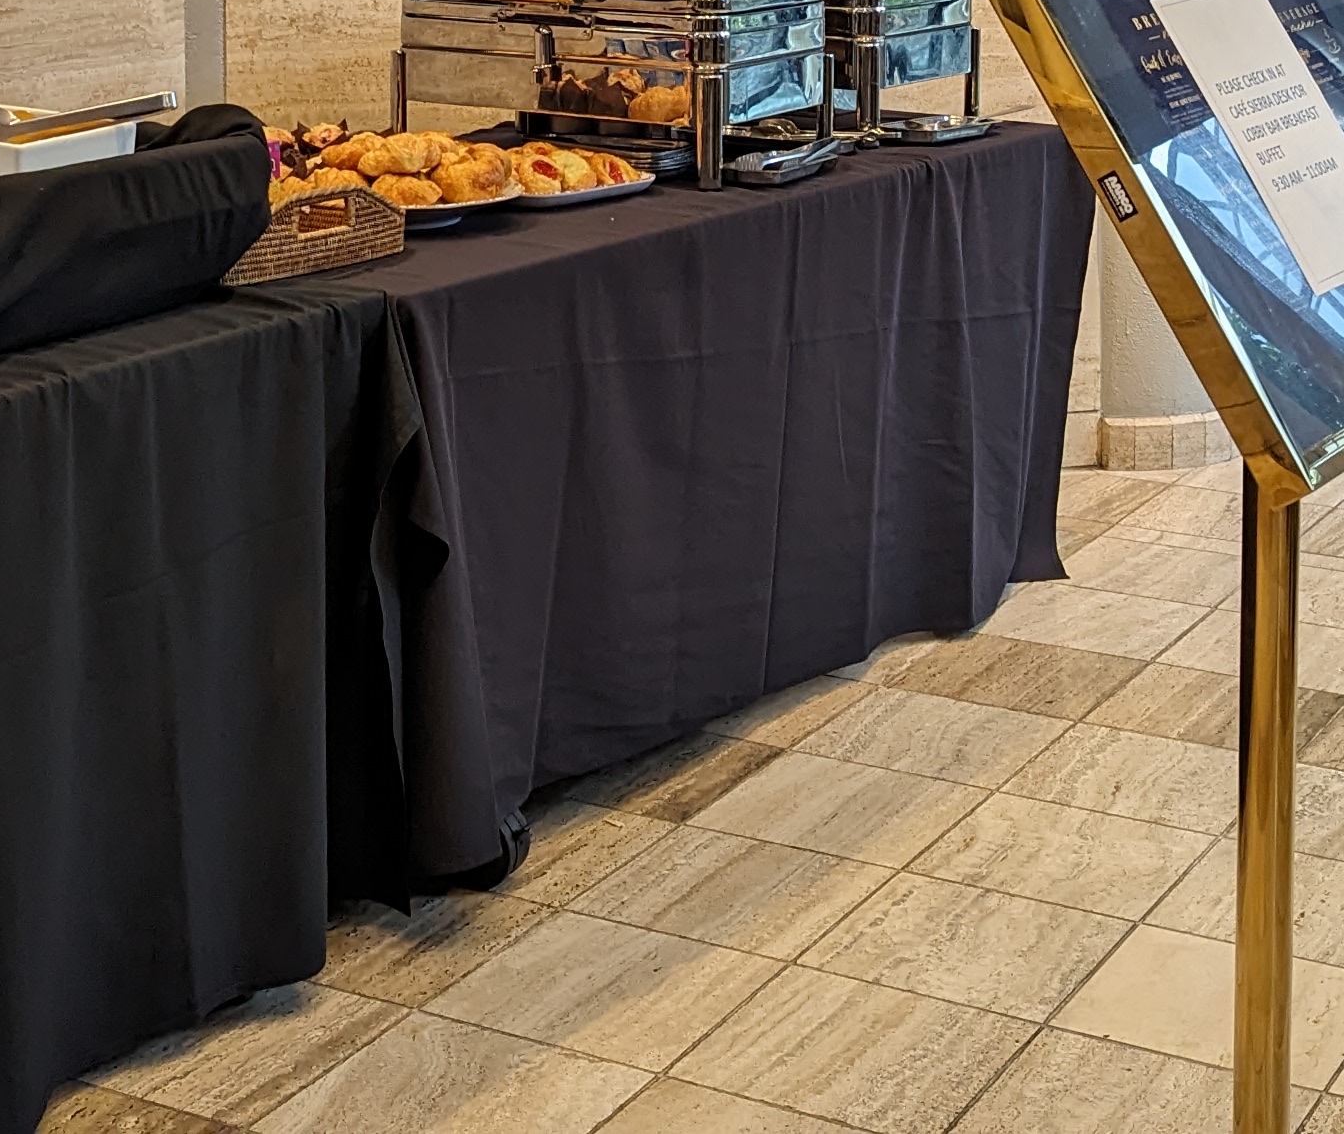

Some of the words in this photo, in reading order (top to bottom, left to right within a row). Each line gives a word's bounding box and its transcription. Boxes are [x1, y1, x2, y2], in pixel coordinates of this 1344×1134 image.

[1277, 2, 1320, 23] EVERAGE
[1215, 77, 1244, 96] PLEASE
[1242, 68, 1268, 88] CHECK
[1266, 66, 1276, 81] IN
[1275, 64, 1286, 79] AT
[1229, 99, 1250, 119] CAFÉ
[1248, 94, 1275, 113] SIERRA
[1274, 89, 1293, 106] DESK
[1291, 84, 1307, 99] FOR
[1242, 123, 1268, 142] LOBBY
[1265, 118, 1282, 135] BAR
[1279, 106, 1320, 130] BREAKFAST
[1256, 145, 1286, 166] BUFFET
[1271, 177, 1290, 192] 9:30
[1289, 170, 1304, 186] AM
[1306, 157, 1339, 179] 11:00AM
